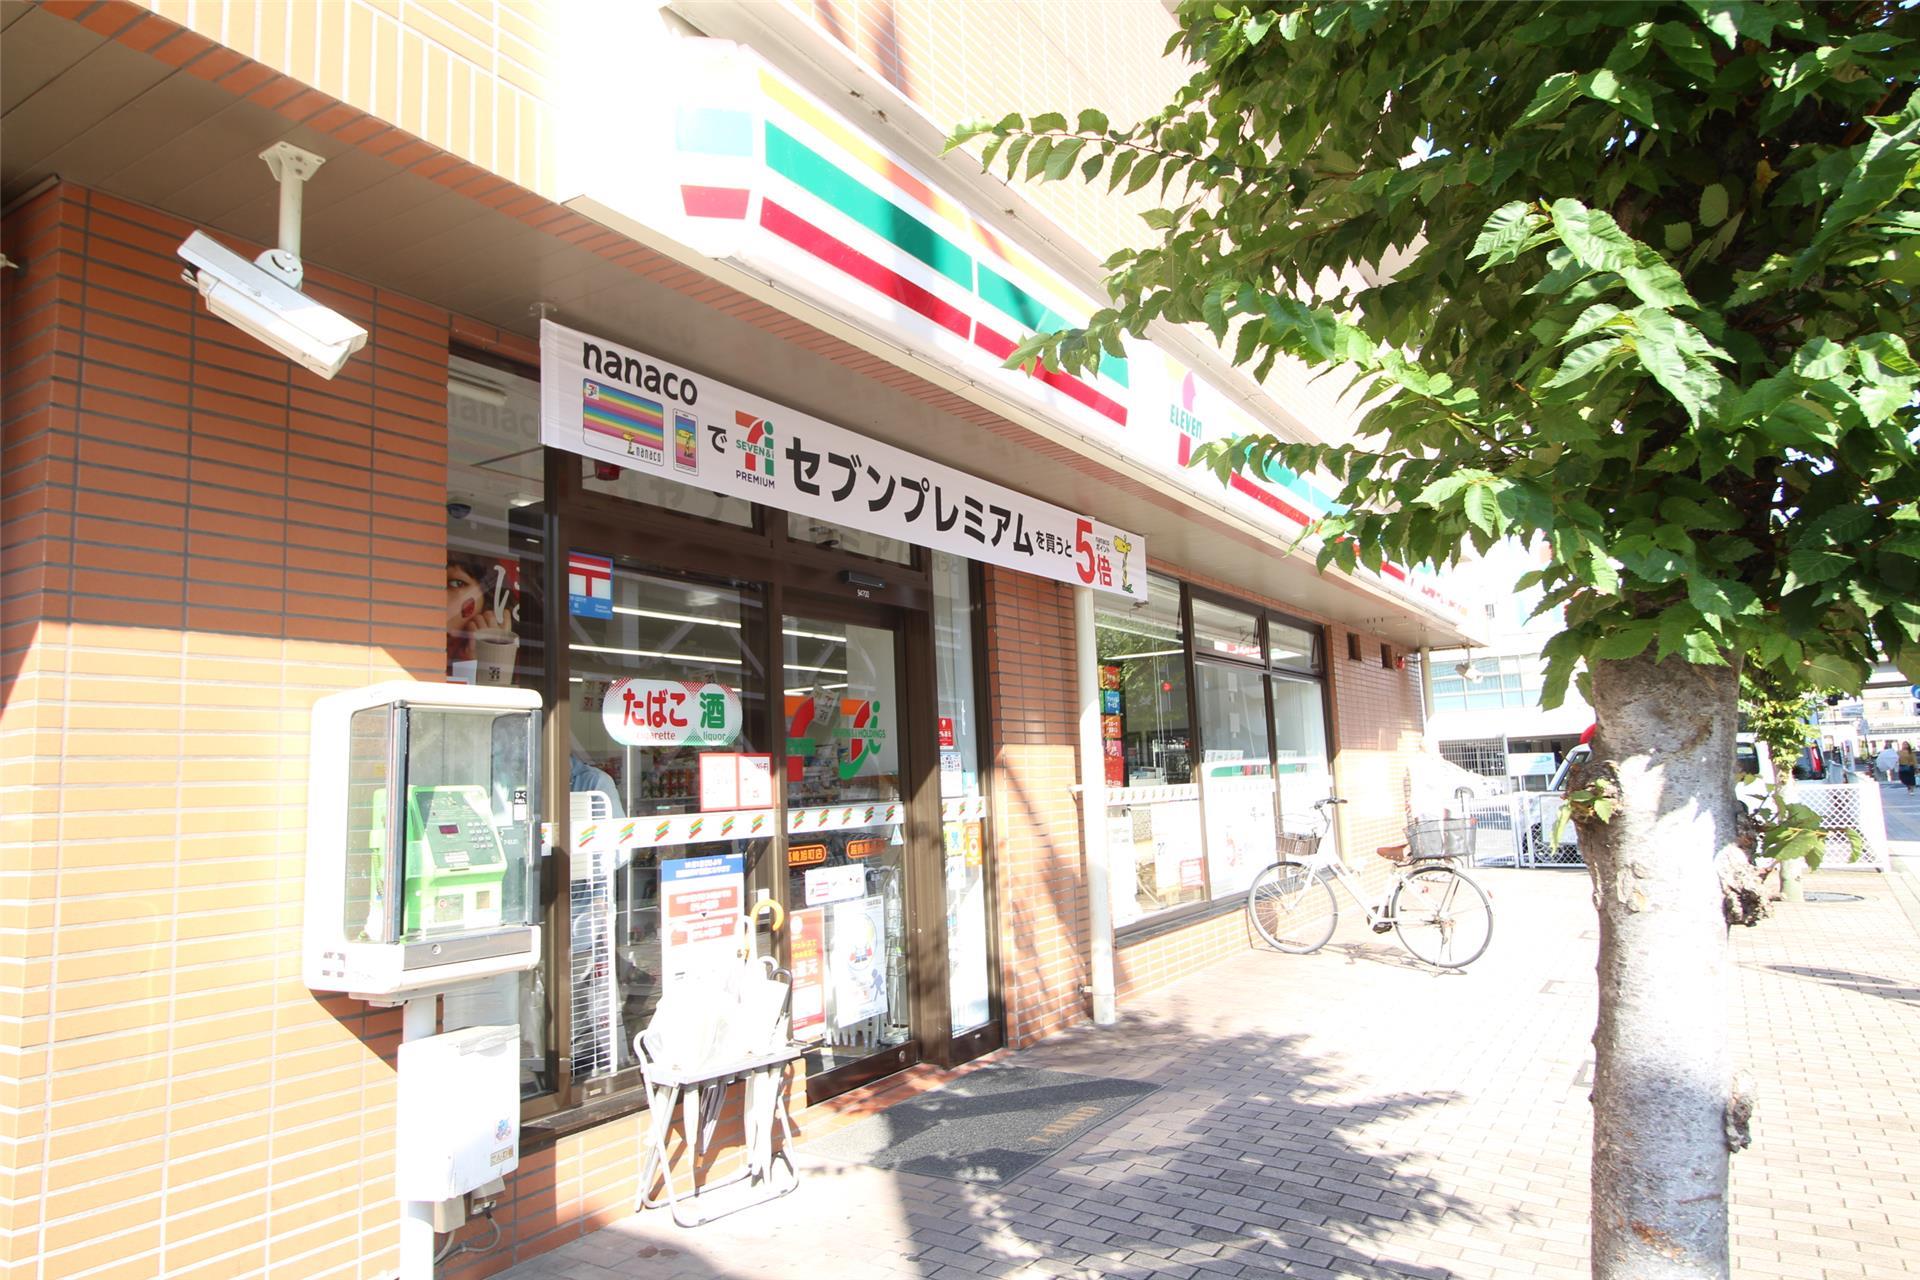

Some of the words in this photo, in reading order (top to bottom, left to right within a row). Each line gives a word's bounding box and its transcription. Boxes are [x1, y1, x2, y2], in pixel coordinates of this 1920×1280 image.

[583, 342, 698, 405] nanaco
[707, 425, 727, 453] で
[635, 446, 661, 463] nanaco
[736, 470, 776, 490] PREMIUM
[623, 688, 688, 728] たばこ
[700, 691, 726, 729] 酒
[637, 730, 676, 741] carette
[702, 730, 726, 742] liquor
